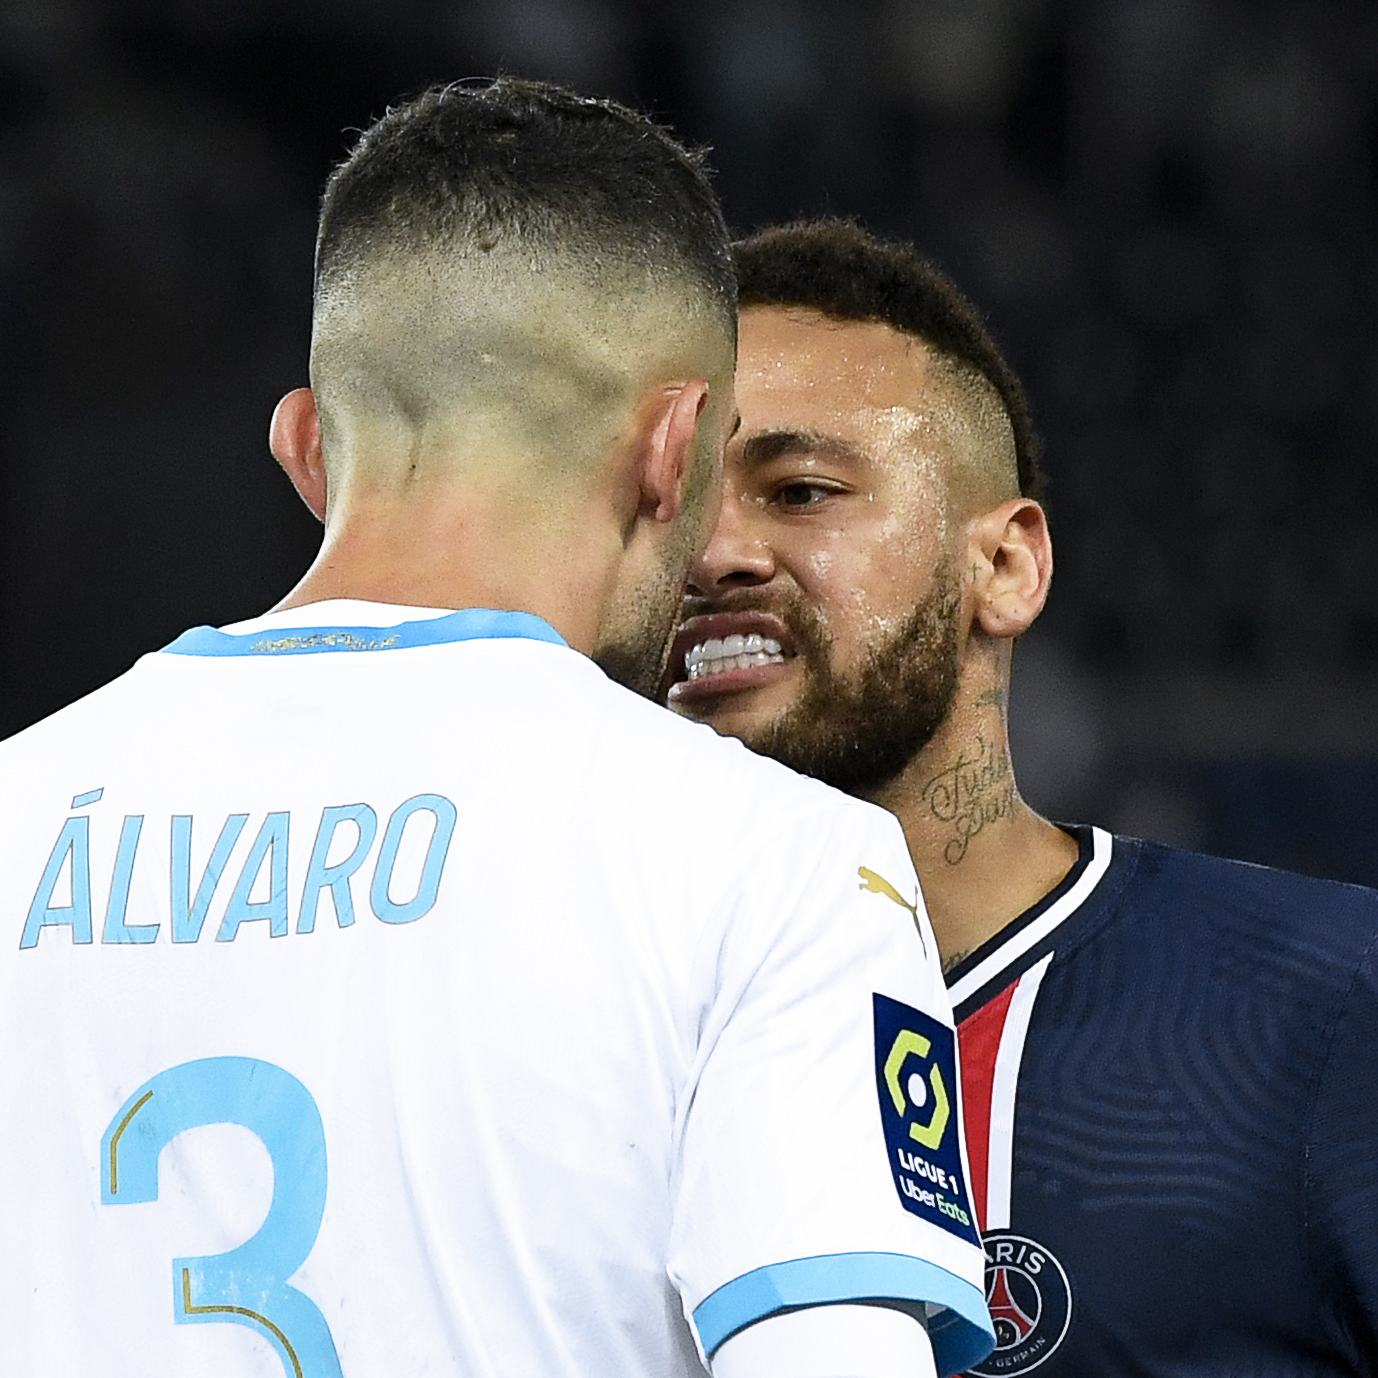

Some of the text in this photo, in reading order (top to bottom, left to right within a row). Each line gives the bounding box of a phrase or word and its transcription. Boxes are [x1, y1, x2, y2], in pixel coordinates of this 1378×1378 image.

[19, 787, 458, 950] ÁLVARO
[897, 1147, 959, 1196] LIGUE 1
[898, 1174, 971, 1227] Uber Eats
